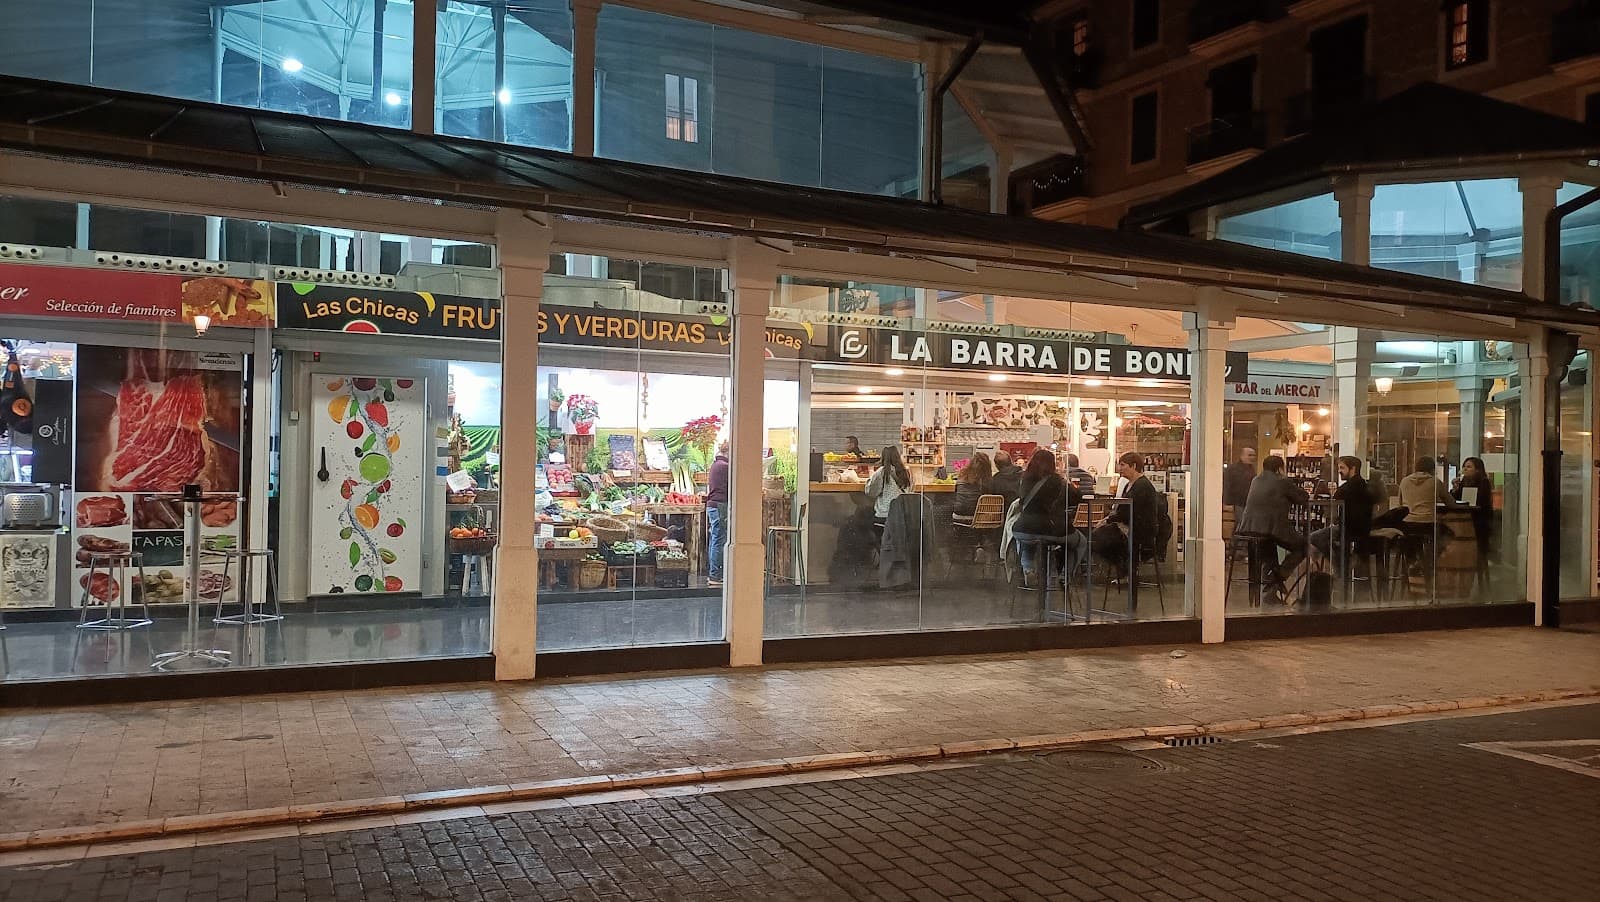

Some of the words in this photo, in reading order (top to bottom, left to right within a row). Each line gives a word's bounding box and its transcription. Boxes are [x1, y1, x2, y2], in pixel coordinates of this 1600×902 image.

[0, 286, 29, 300] er
[46, 299, 103, 313] Selección
[107, 303, 122, 315] de
[122, 304, 177, 318] fiambres
[303, 299, 342, 319] Las
[345, 296, 420, 325] Chicas
[442, 304, 548, 334] FRUS
[553, 313, 571, 335] Y
[574, 314, 706, 344] VERDURAS
[891, 335, 933, 362] LA
[951, 339, 1058, 369] BARRA
[1074, 347, 1112, 372] DE
[1235, 383, 1258, 395] BAR
[1274, 384, 1321, 398] MERCAT
[132, 535, 184, 547] TAPAS
